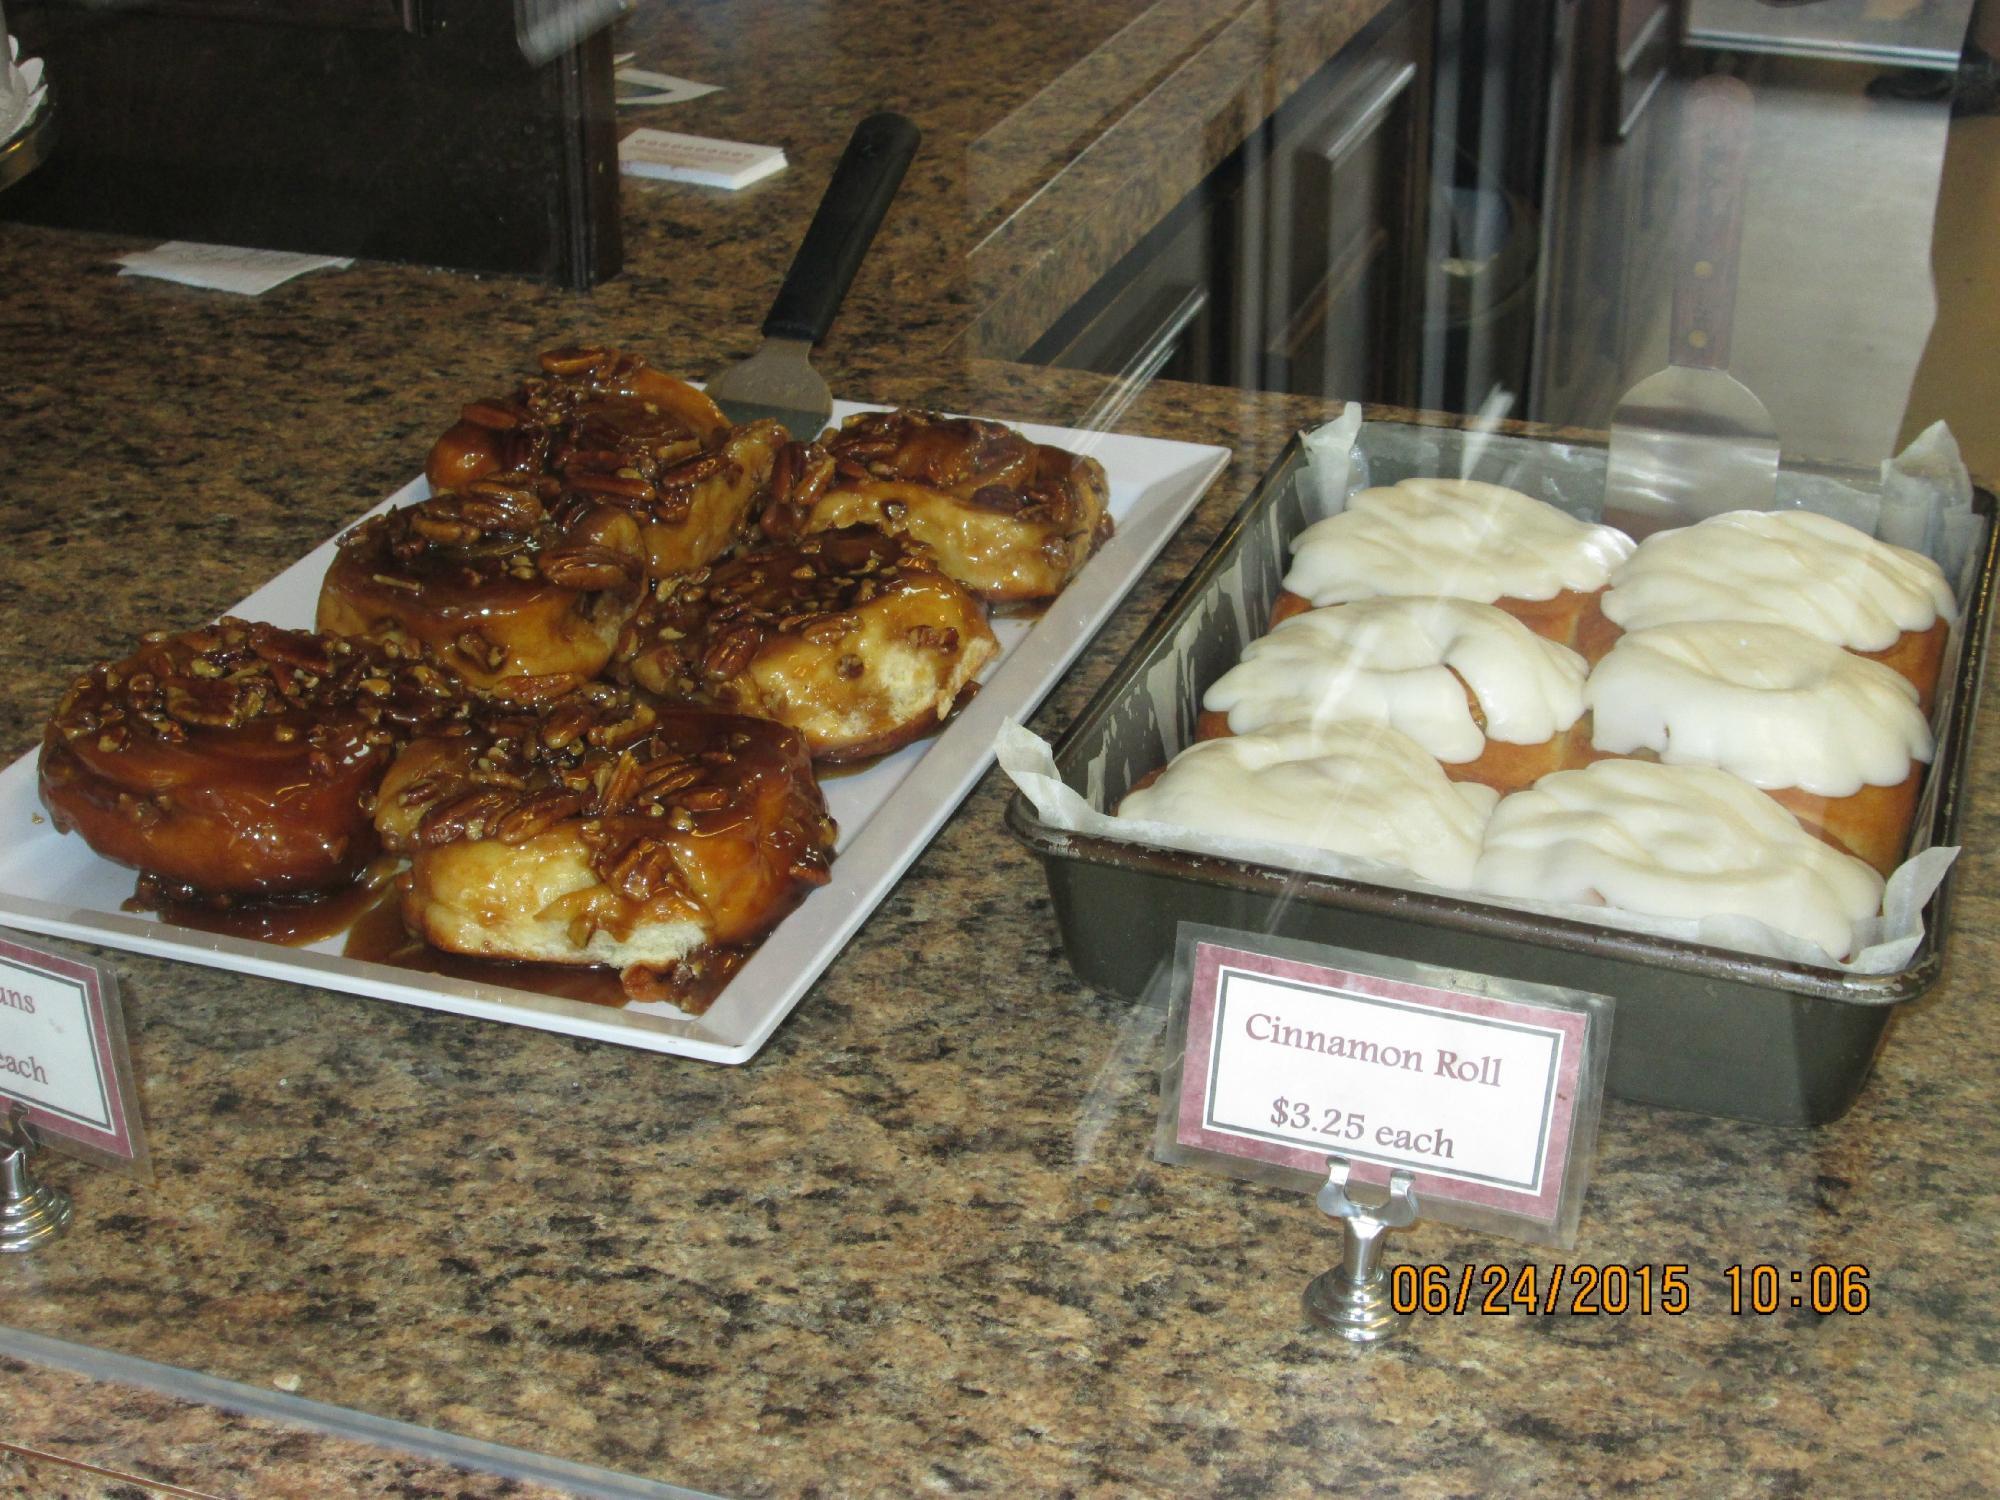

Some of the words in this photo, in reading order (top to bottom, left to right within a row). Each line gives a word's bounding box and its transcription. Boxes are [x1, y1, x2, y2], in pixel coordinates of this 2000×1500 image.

[1245, 1013, 1424, 1073] Cinnamon
[1434, 1049, 1503, 1087] Roll
[1270, 1096, 1366, 1140] $3.25
[1375, 1126, 1455, 1159] each
